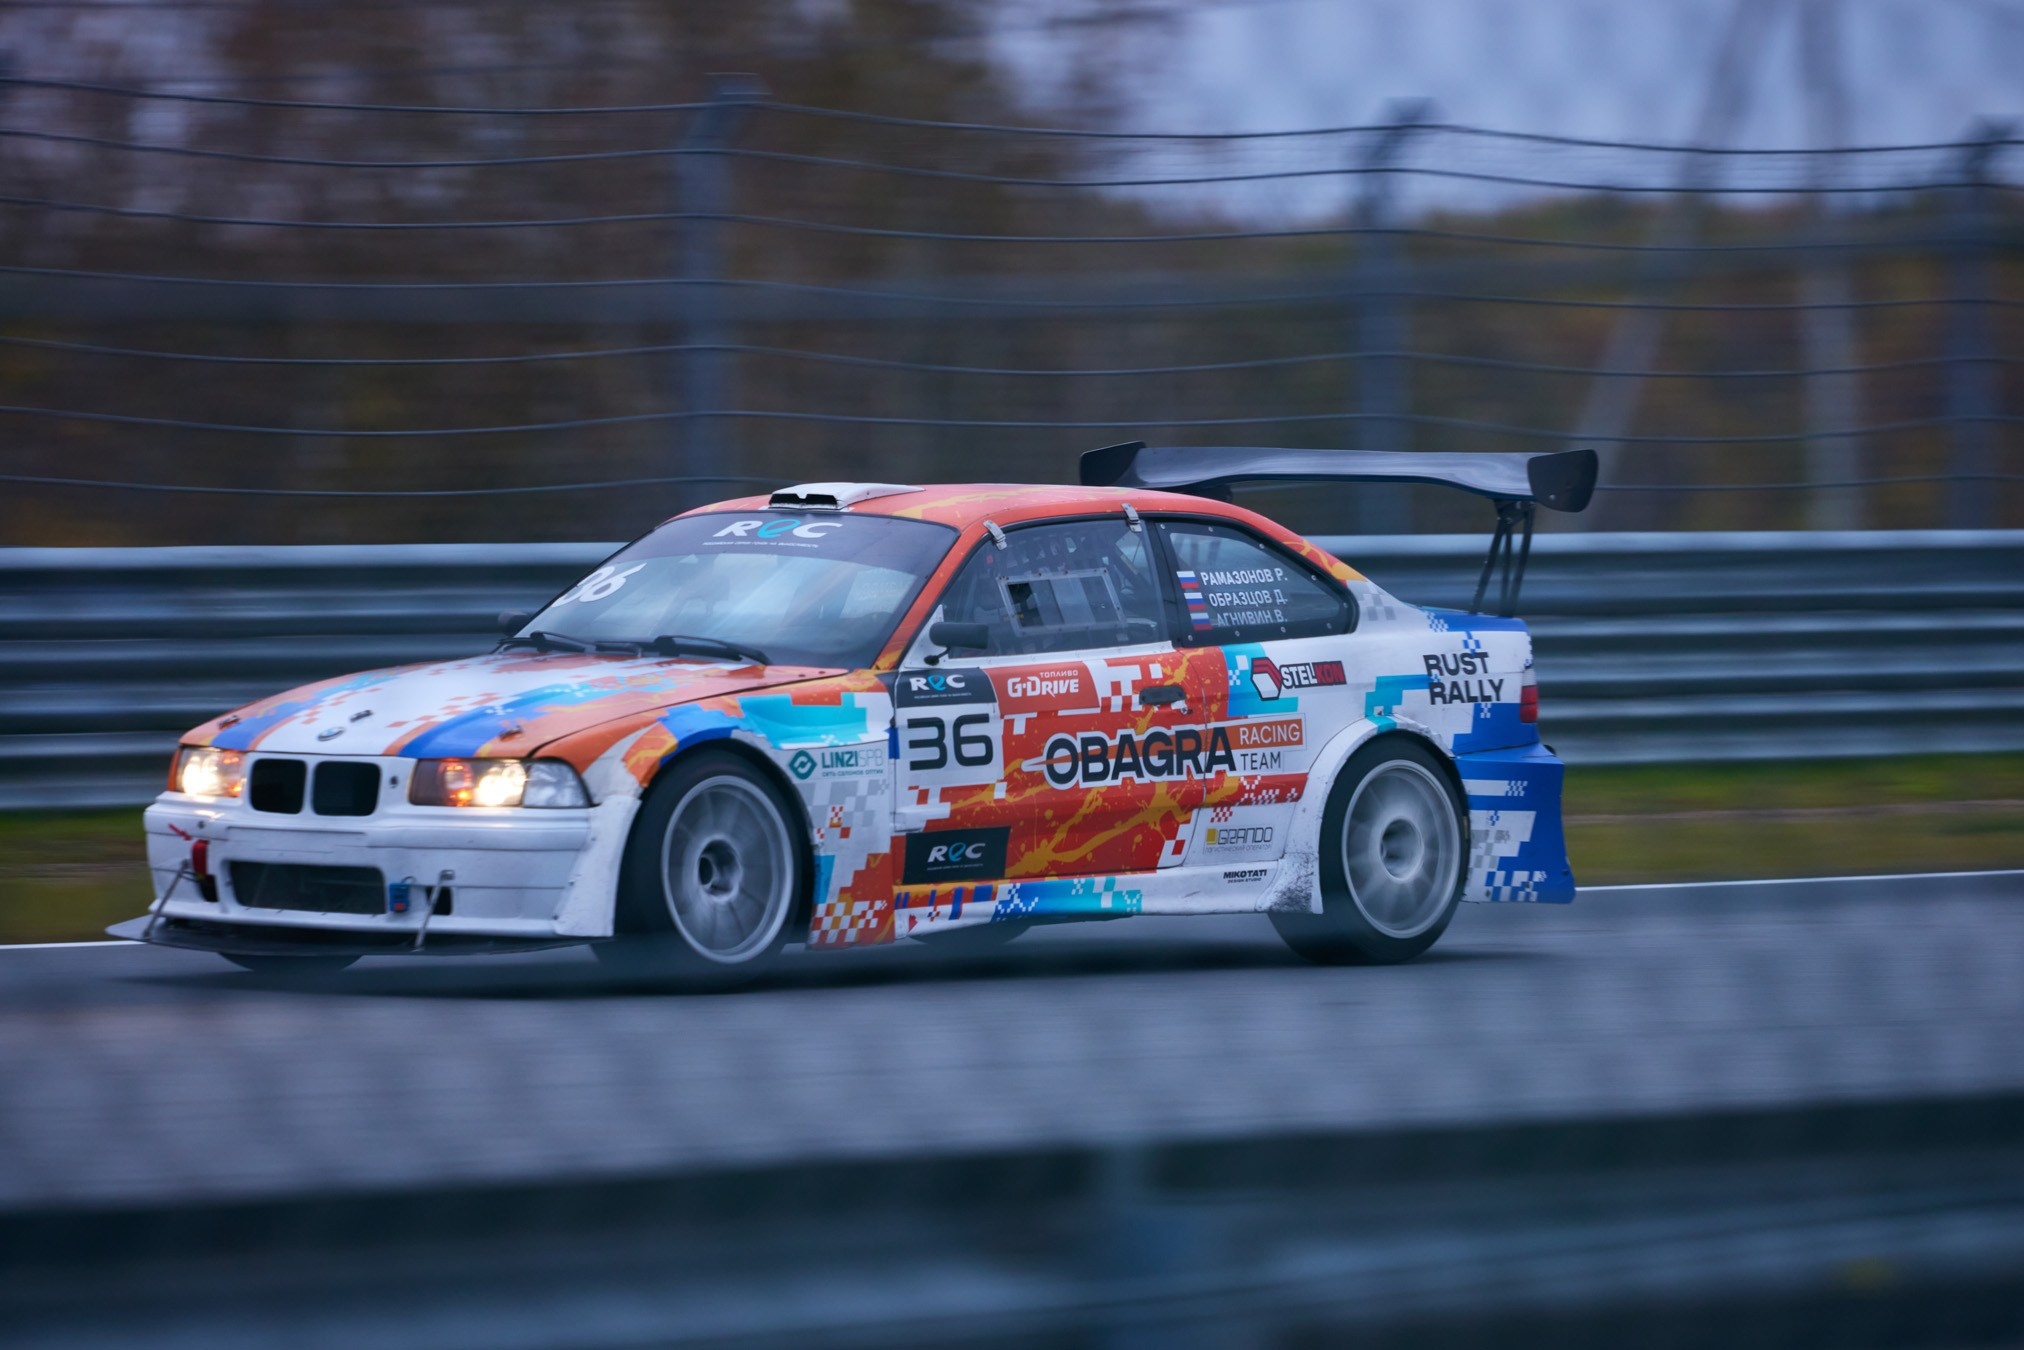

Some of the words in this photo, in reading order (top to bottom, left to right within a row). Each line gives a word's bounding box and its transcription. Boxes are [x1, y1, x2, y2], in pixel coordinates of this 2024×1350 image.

[1201, 569, 1273, 586] РАМАЗОНОВ
[1275, 567, 1288, 582] Р.
[1209, 590, 1273, 608] ОБРАЗЦОВ
[1275, 589, 1288, 605] Д.
[1217, 610, 1271, 627] АГНИВИН
[1274, 609, 1288, 622] В.
[1423, 651, 1489, 677] RUST
[1428, 678, 1504, 705] RALLY
[907, 713, 994, 771] 36
[1239, 723, 1301, 745] RACING
[1045, 726, 1237, 784] OBAGRA
[1240, 751, 1282, 771] TEAM
[1223, 869, 1268, 879] MIKOTATI
